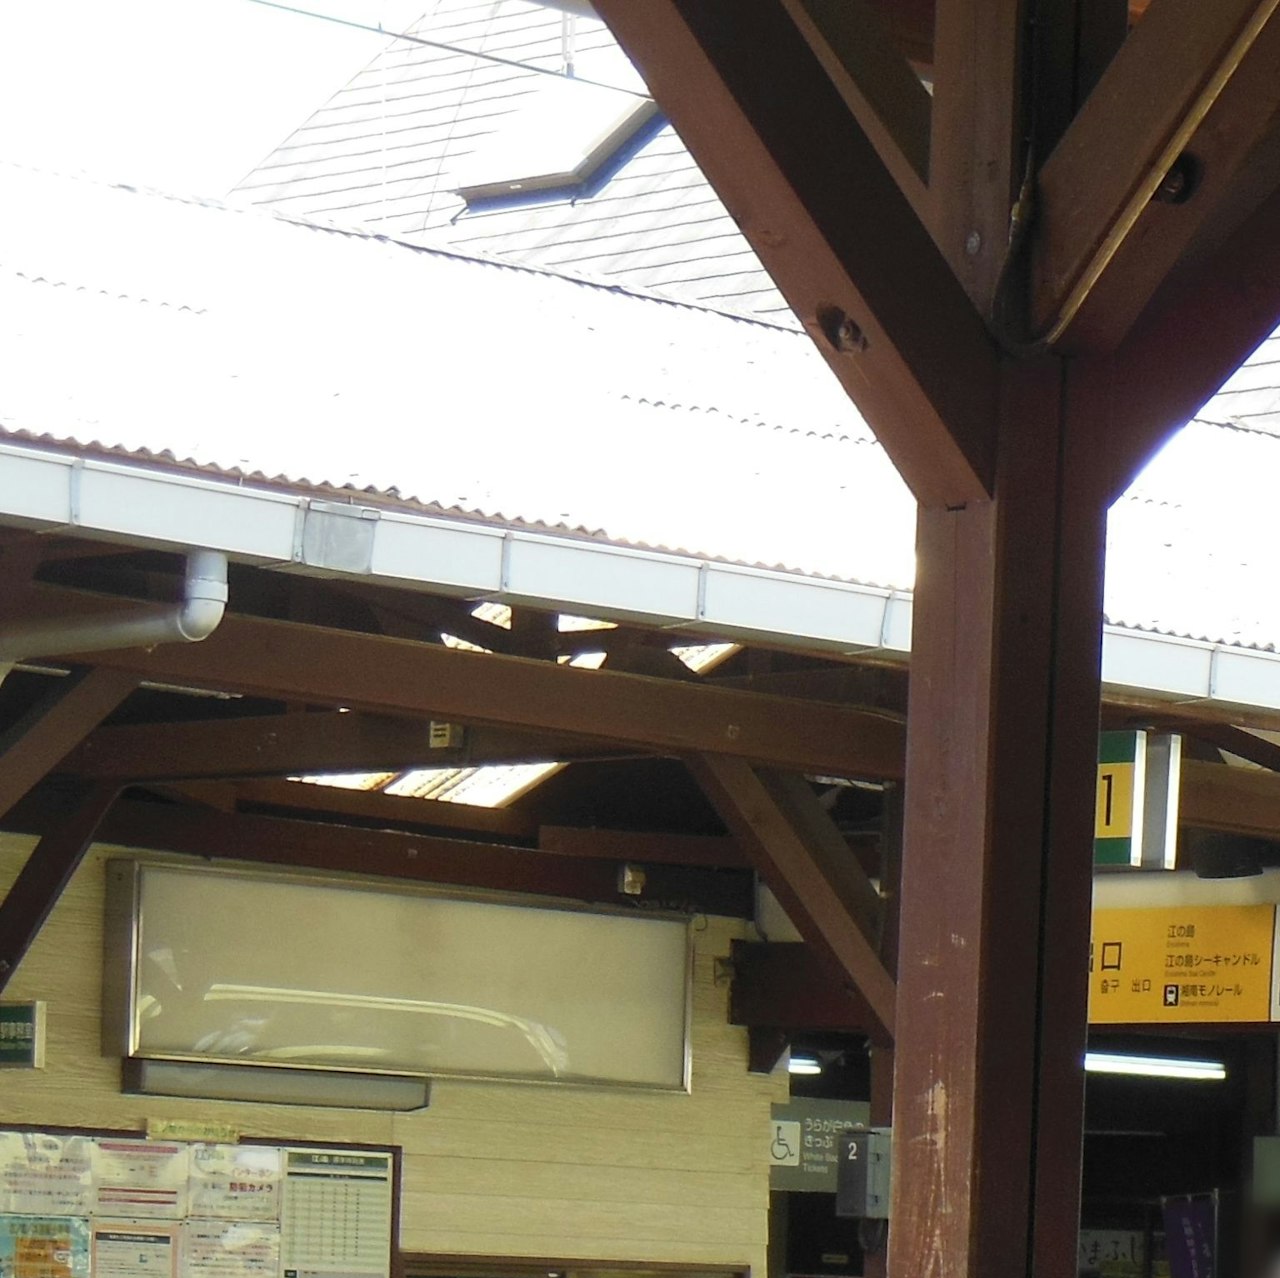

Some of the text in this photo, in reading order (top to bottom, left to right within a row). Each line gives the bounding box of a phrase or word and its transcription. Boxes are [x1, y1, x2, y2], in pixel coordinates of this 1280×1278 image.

[1102, 775, 1112, 827] 1
[1167, 924, 1196, 939] 江の島
[1131, 978, 1152, 993] 出口
[847, 1141, 858, 1161] 2
